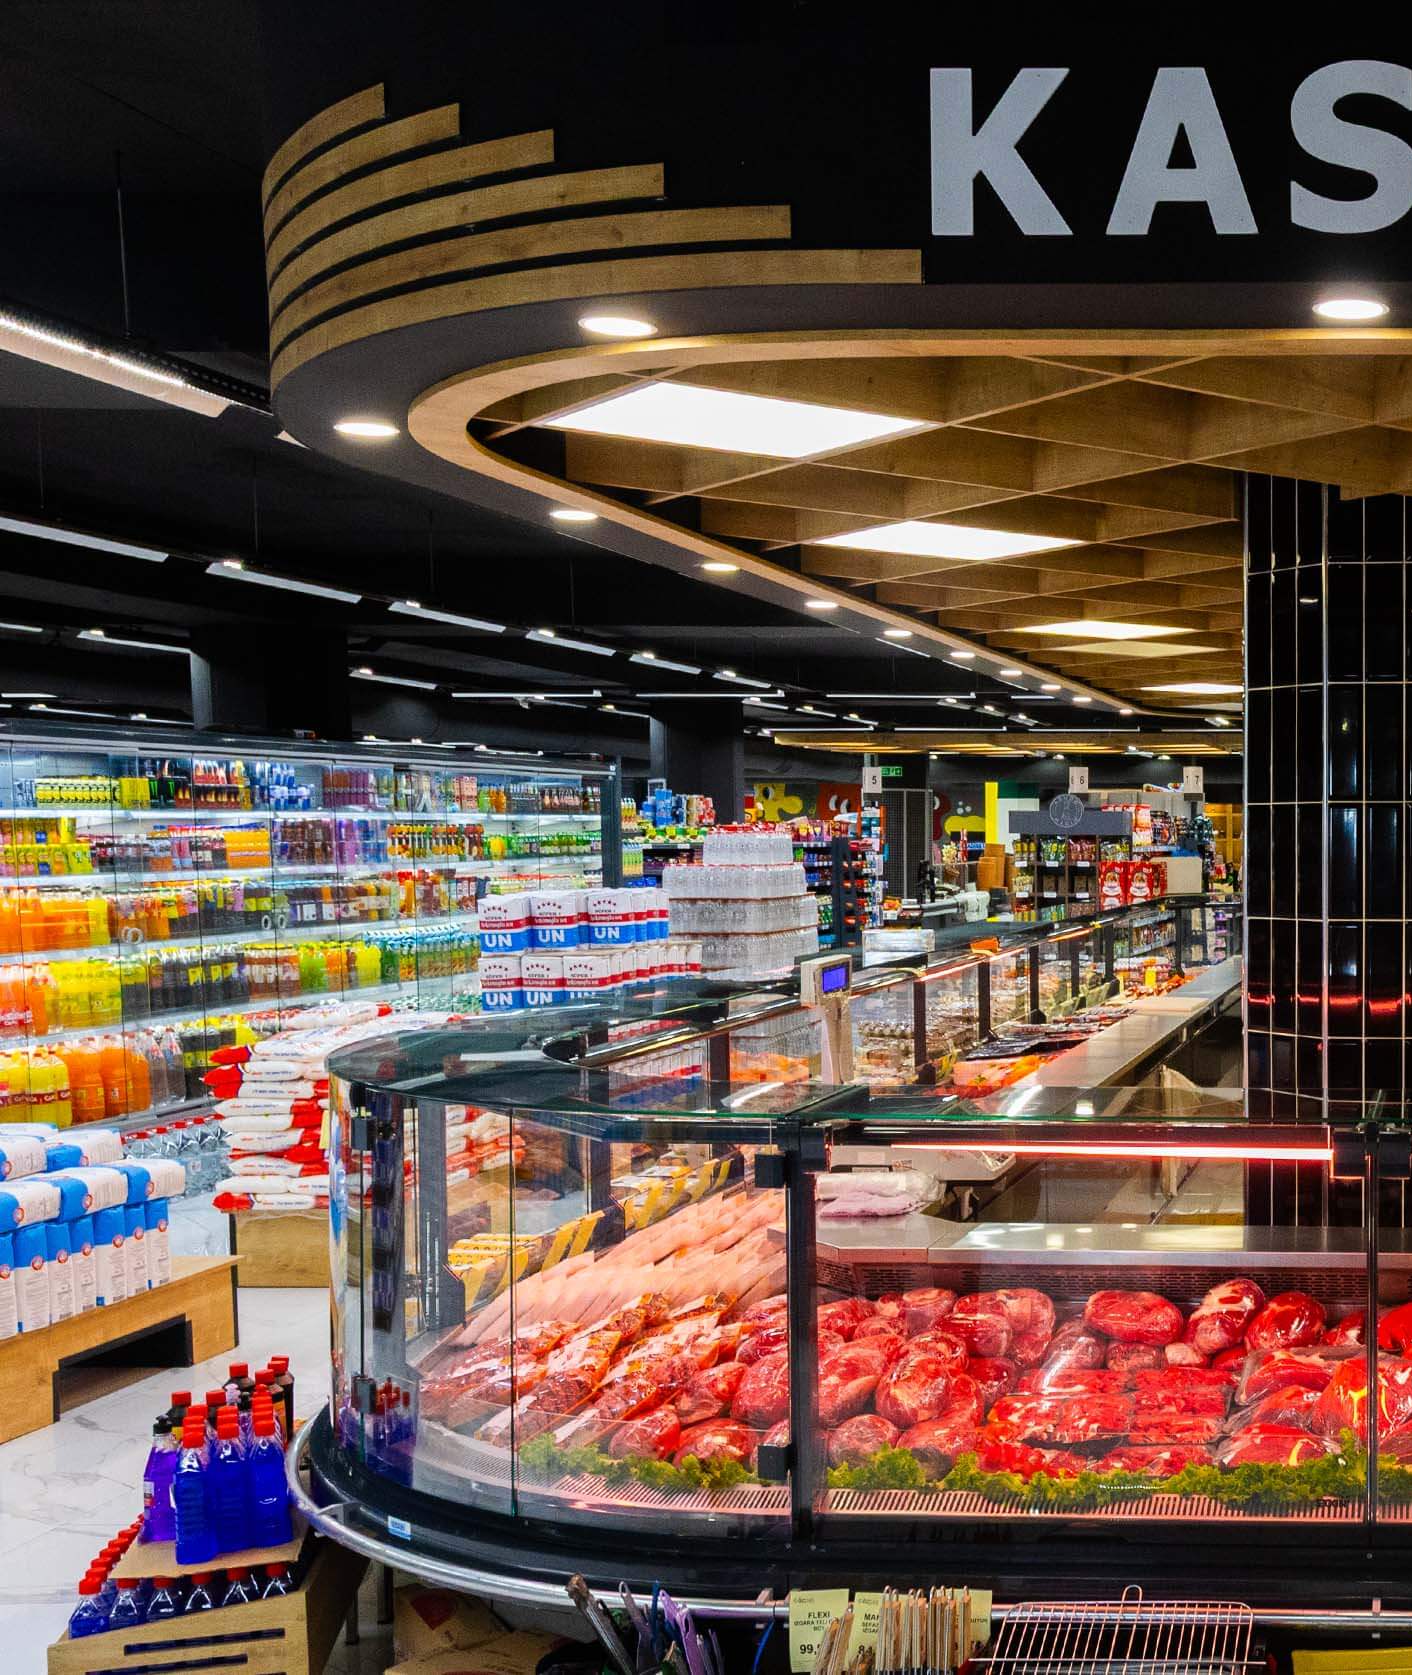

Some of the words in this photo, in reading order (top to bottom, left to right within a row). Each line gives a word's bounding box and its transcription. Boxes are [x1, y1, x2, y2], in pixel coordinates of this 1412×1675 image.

[871, 775, 877, 785] 5
[1194, 775, 1200, 785] 7
[537, 929, 566, 943] UN
[594, 926, 620, 939] UN
[484, 933, 513, 948] UN
[485, 992, 513, 1006] UN
[526, 991, 553, 1006] UN
